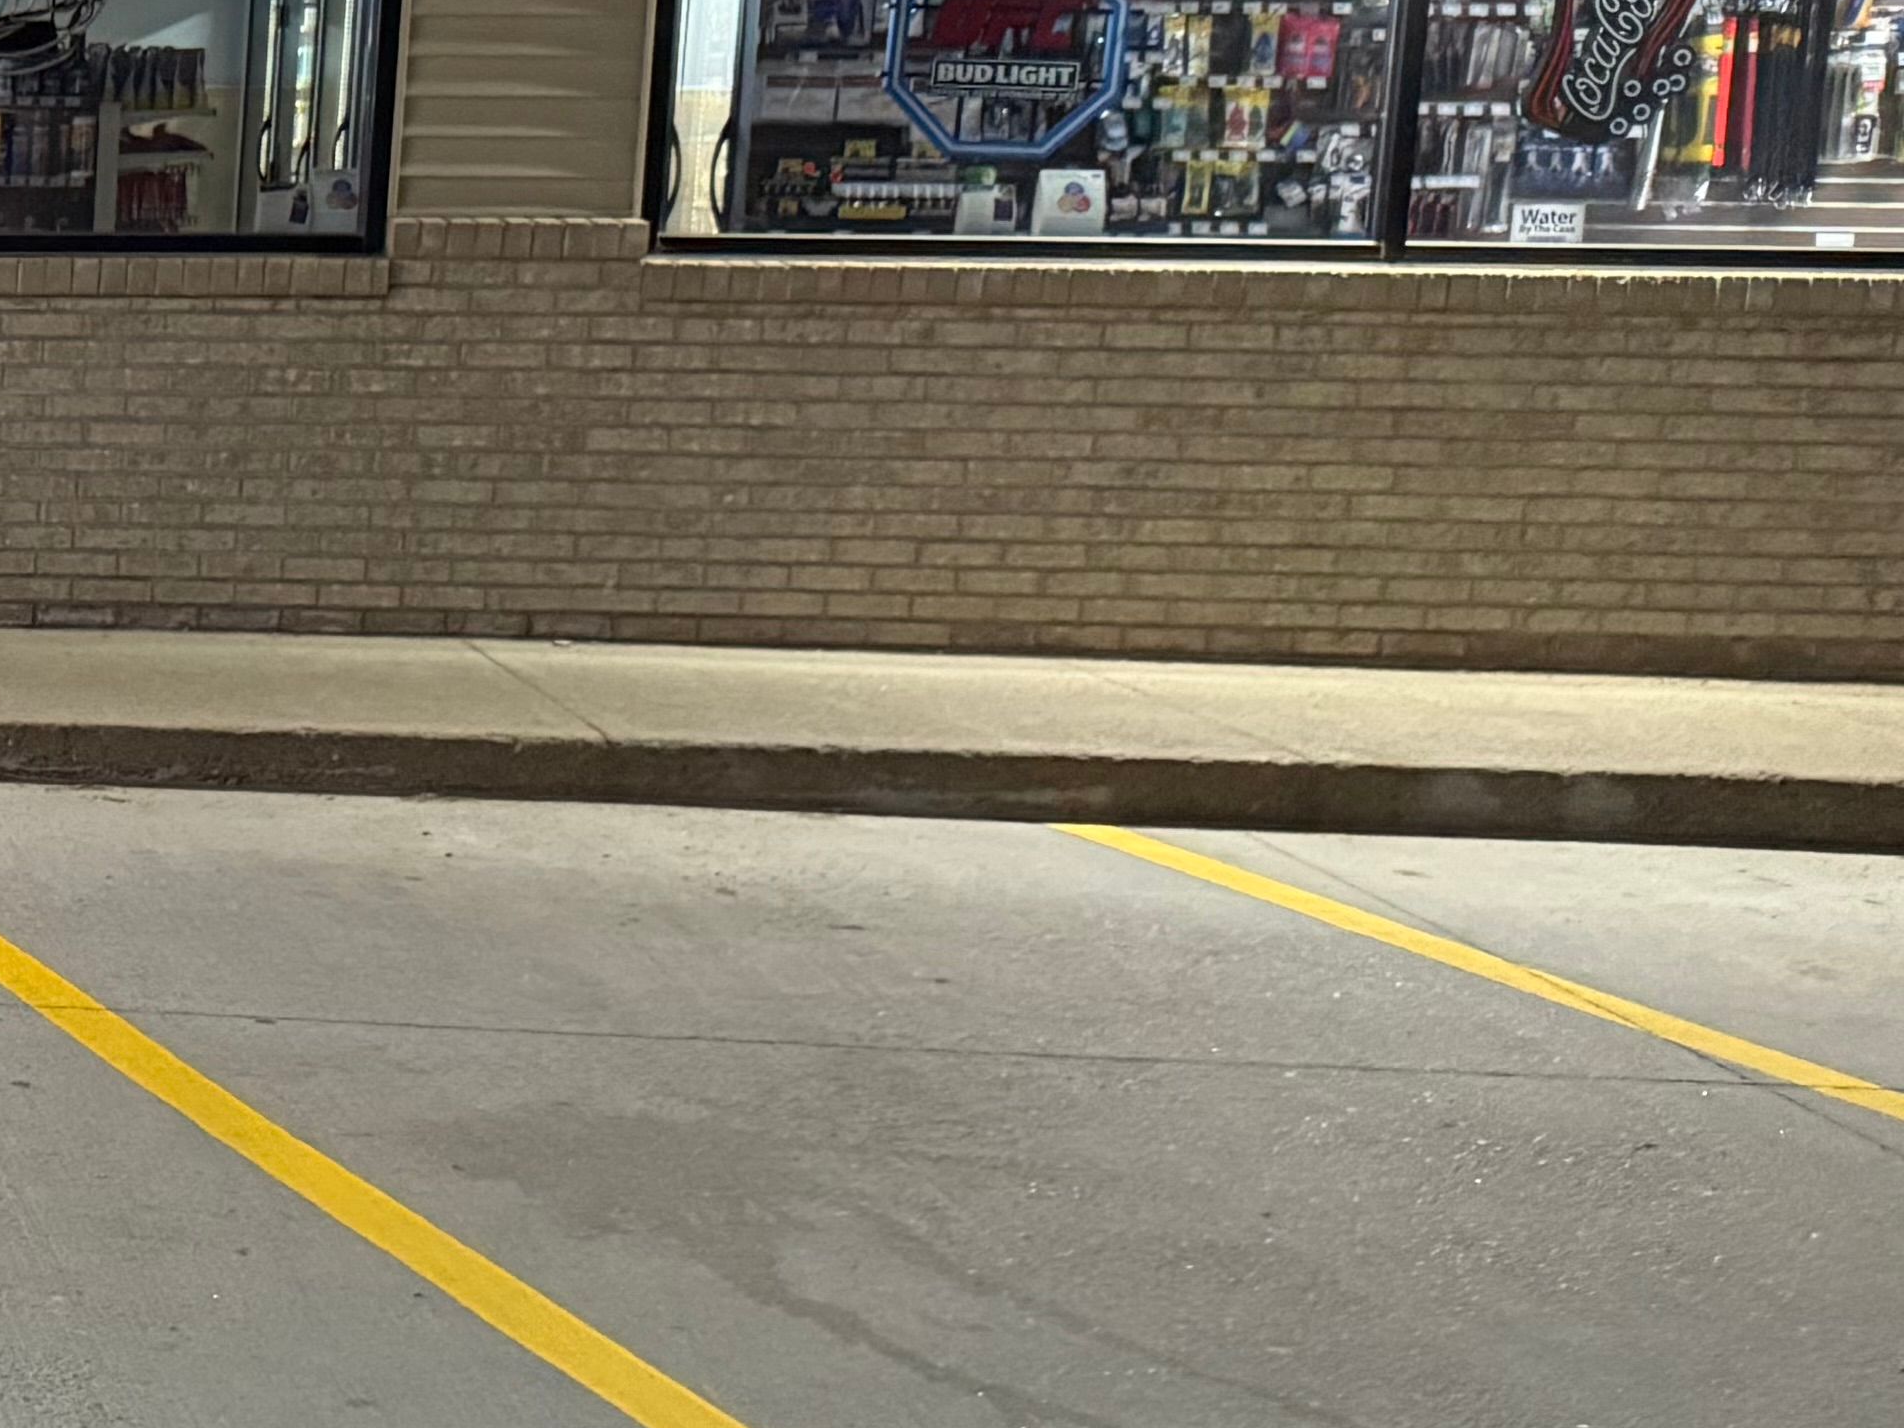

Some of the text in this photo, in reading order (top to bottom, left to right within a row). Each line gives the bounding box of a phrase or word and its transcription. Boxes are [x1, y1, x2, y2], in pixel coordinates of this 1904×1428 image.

[936, 63, 1075, 87] BUD LIGHT
[1521, 208, 1577, 225] Water
